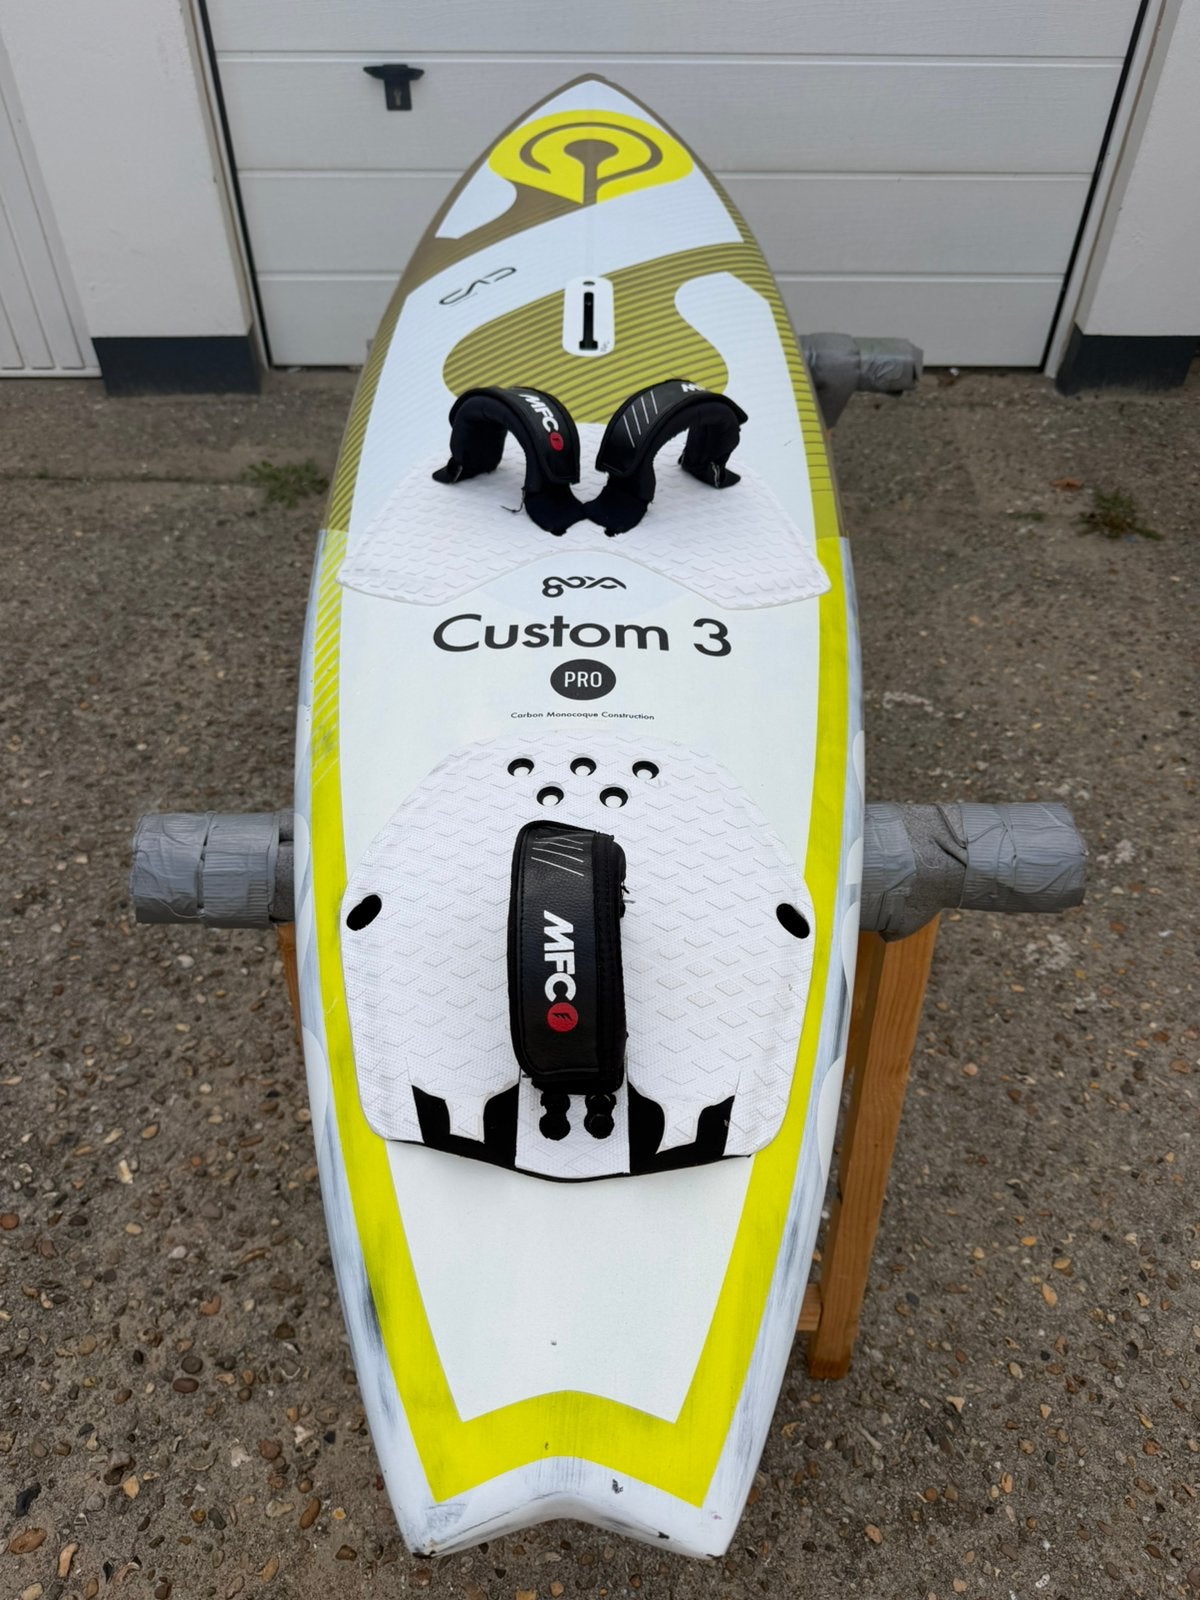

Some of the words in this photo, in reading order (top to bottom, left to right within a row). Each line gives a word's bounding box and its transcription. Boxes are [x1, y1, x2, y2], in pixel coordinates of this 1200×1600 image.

[518, 394, 559, 433] MFC
[433, 613, 669, 652] Custom
[693, 618, 732, 657] 3
[564, 671, 602, 688] PRO
[510, 711, 544, 719] Carbon
[546, 711, 599, 719] Monocoque
[601, 711, 655, 721] Construction
[543, 910, 577, 1002] MFC
